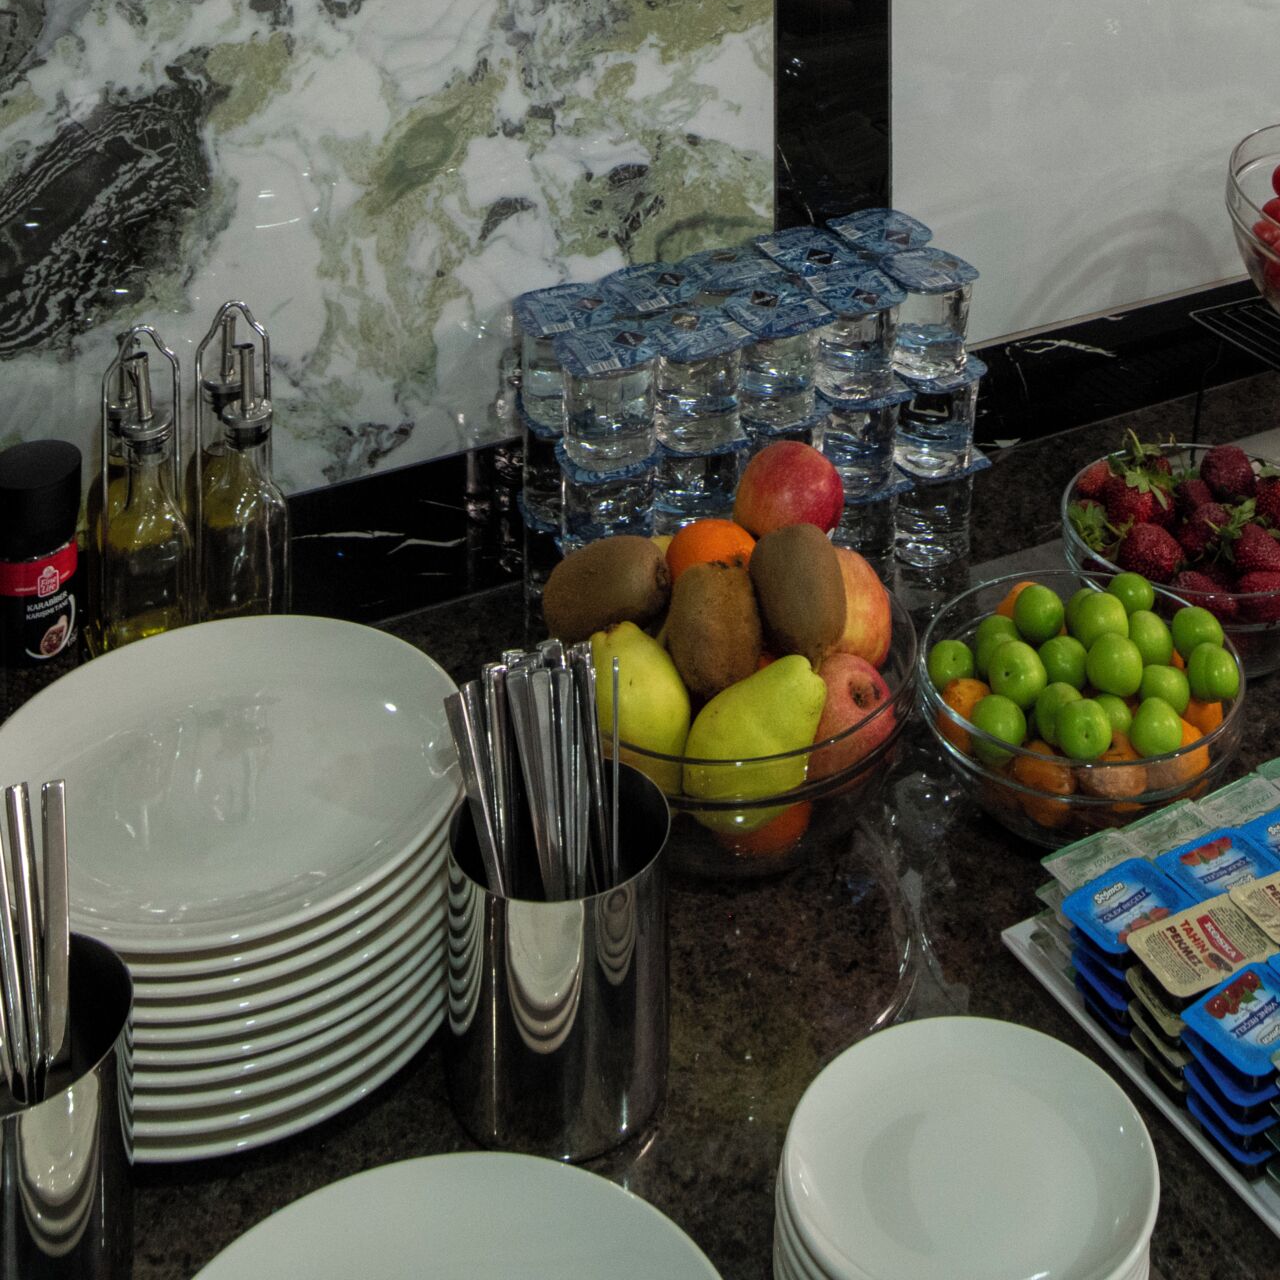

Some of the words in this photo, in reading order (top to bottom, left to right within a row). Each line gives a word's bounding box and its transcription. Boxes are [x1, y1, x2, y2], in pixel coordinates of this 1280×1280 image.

[1167, 926, 1203, 967] PEKMEZ
[1180, 919, 1209, 953] TAHİN
[1204, 921, 1236, 957] KOSKA
